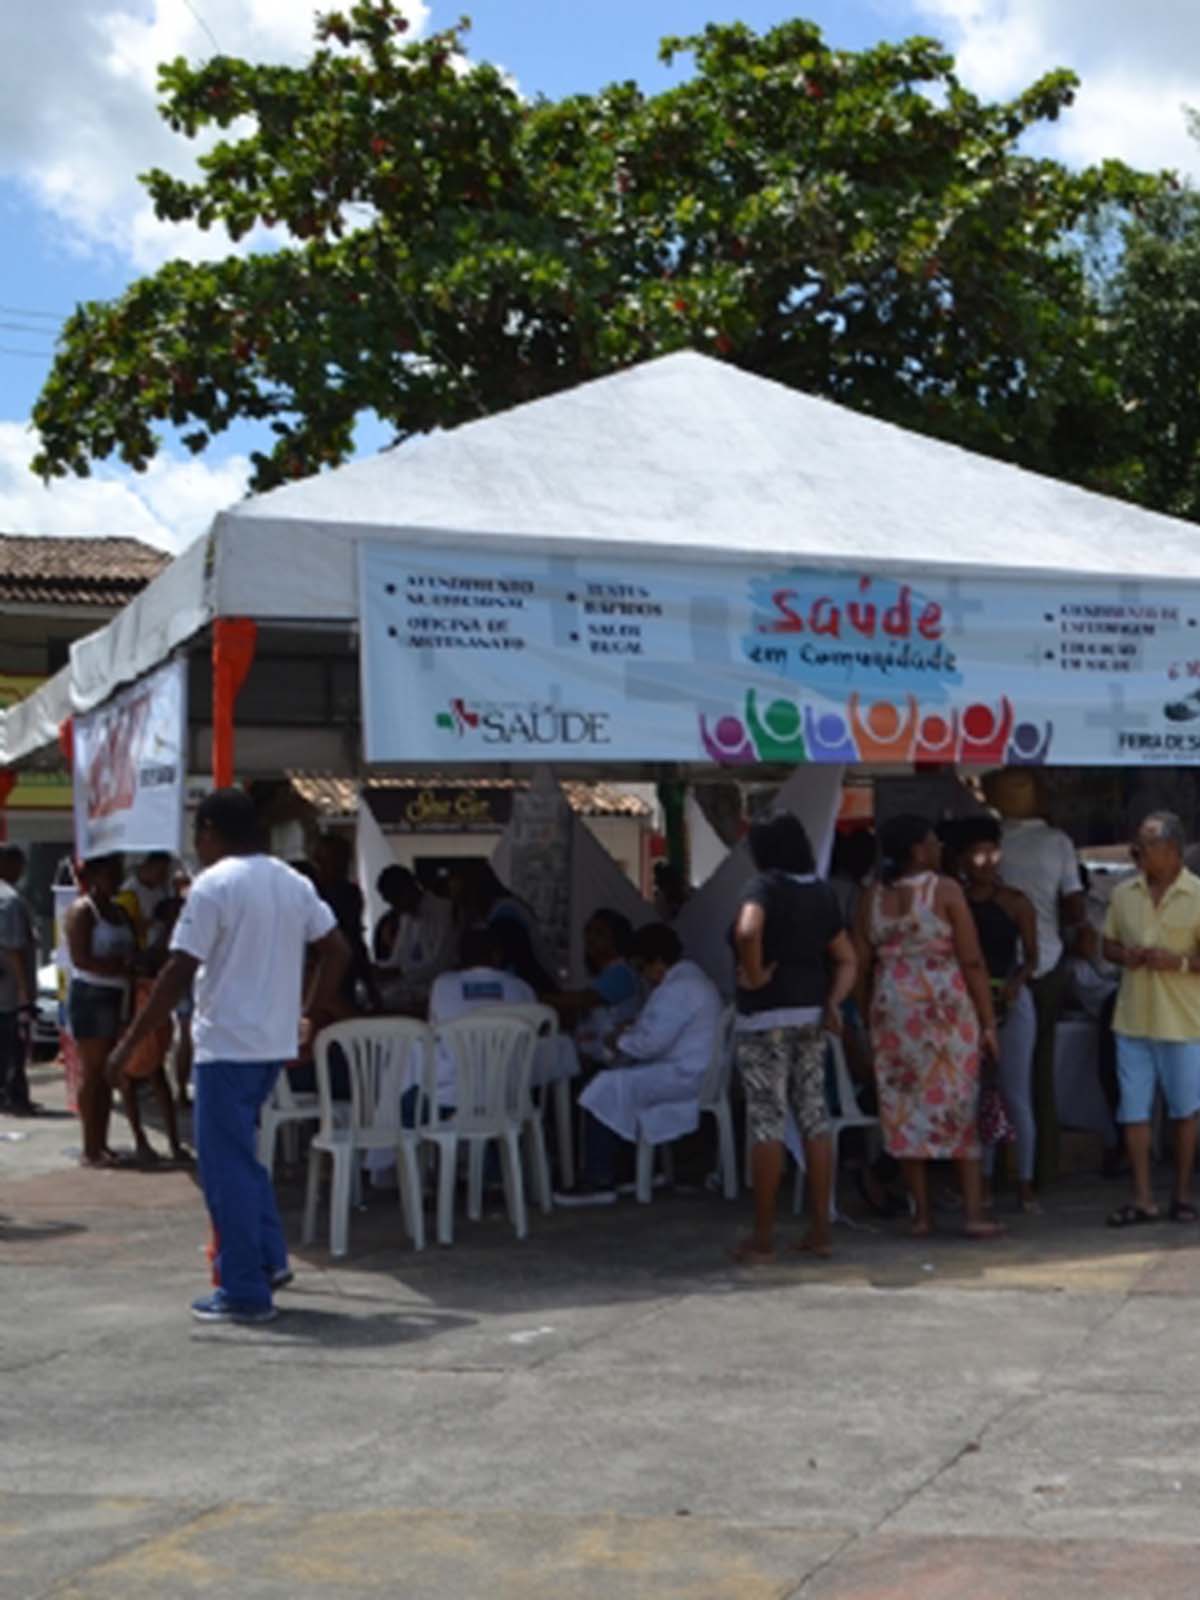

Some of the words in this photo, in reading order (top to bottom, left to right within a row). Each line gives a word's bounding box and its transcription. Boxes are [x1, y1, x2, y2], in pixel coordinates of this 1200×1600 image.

[758, 575, 944, 641] Saúde
[481, 704, 612, 744] SAÚDE
[1165, 733, 1185, 750] DE
